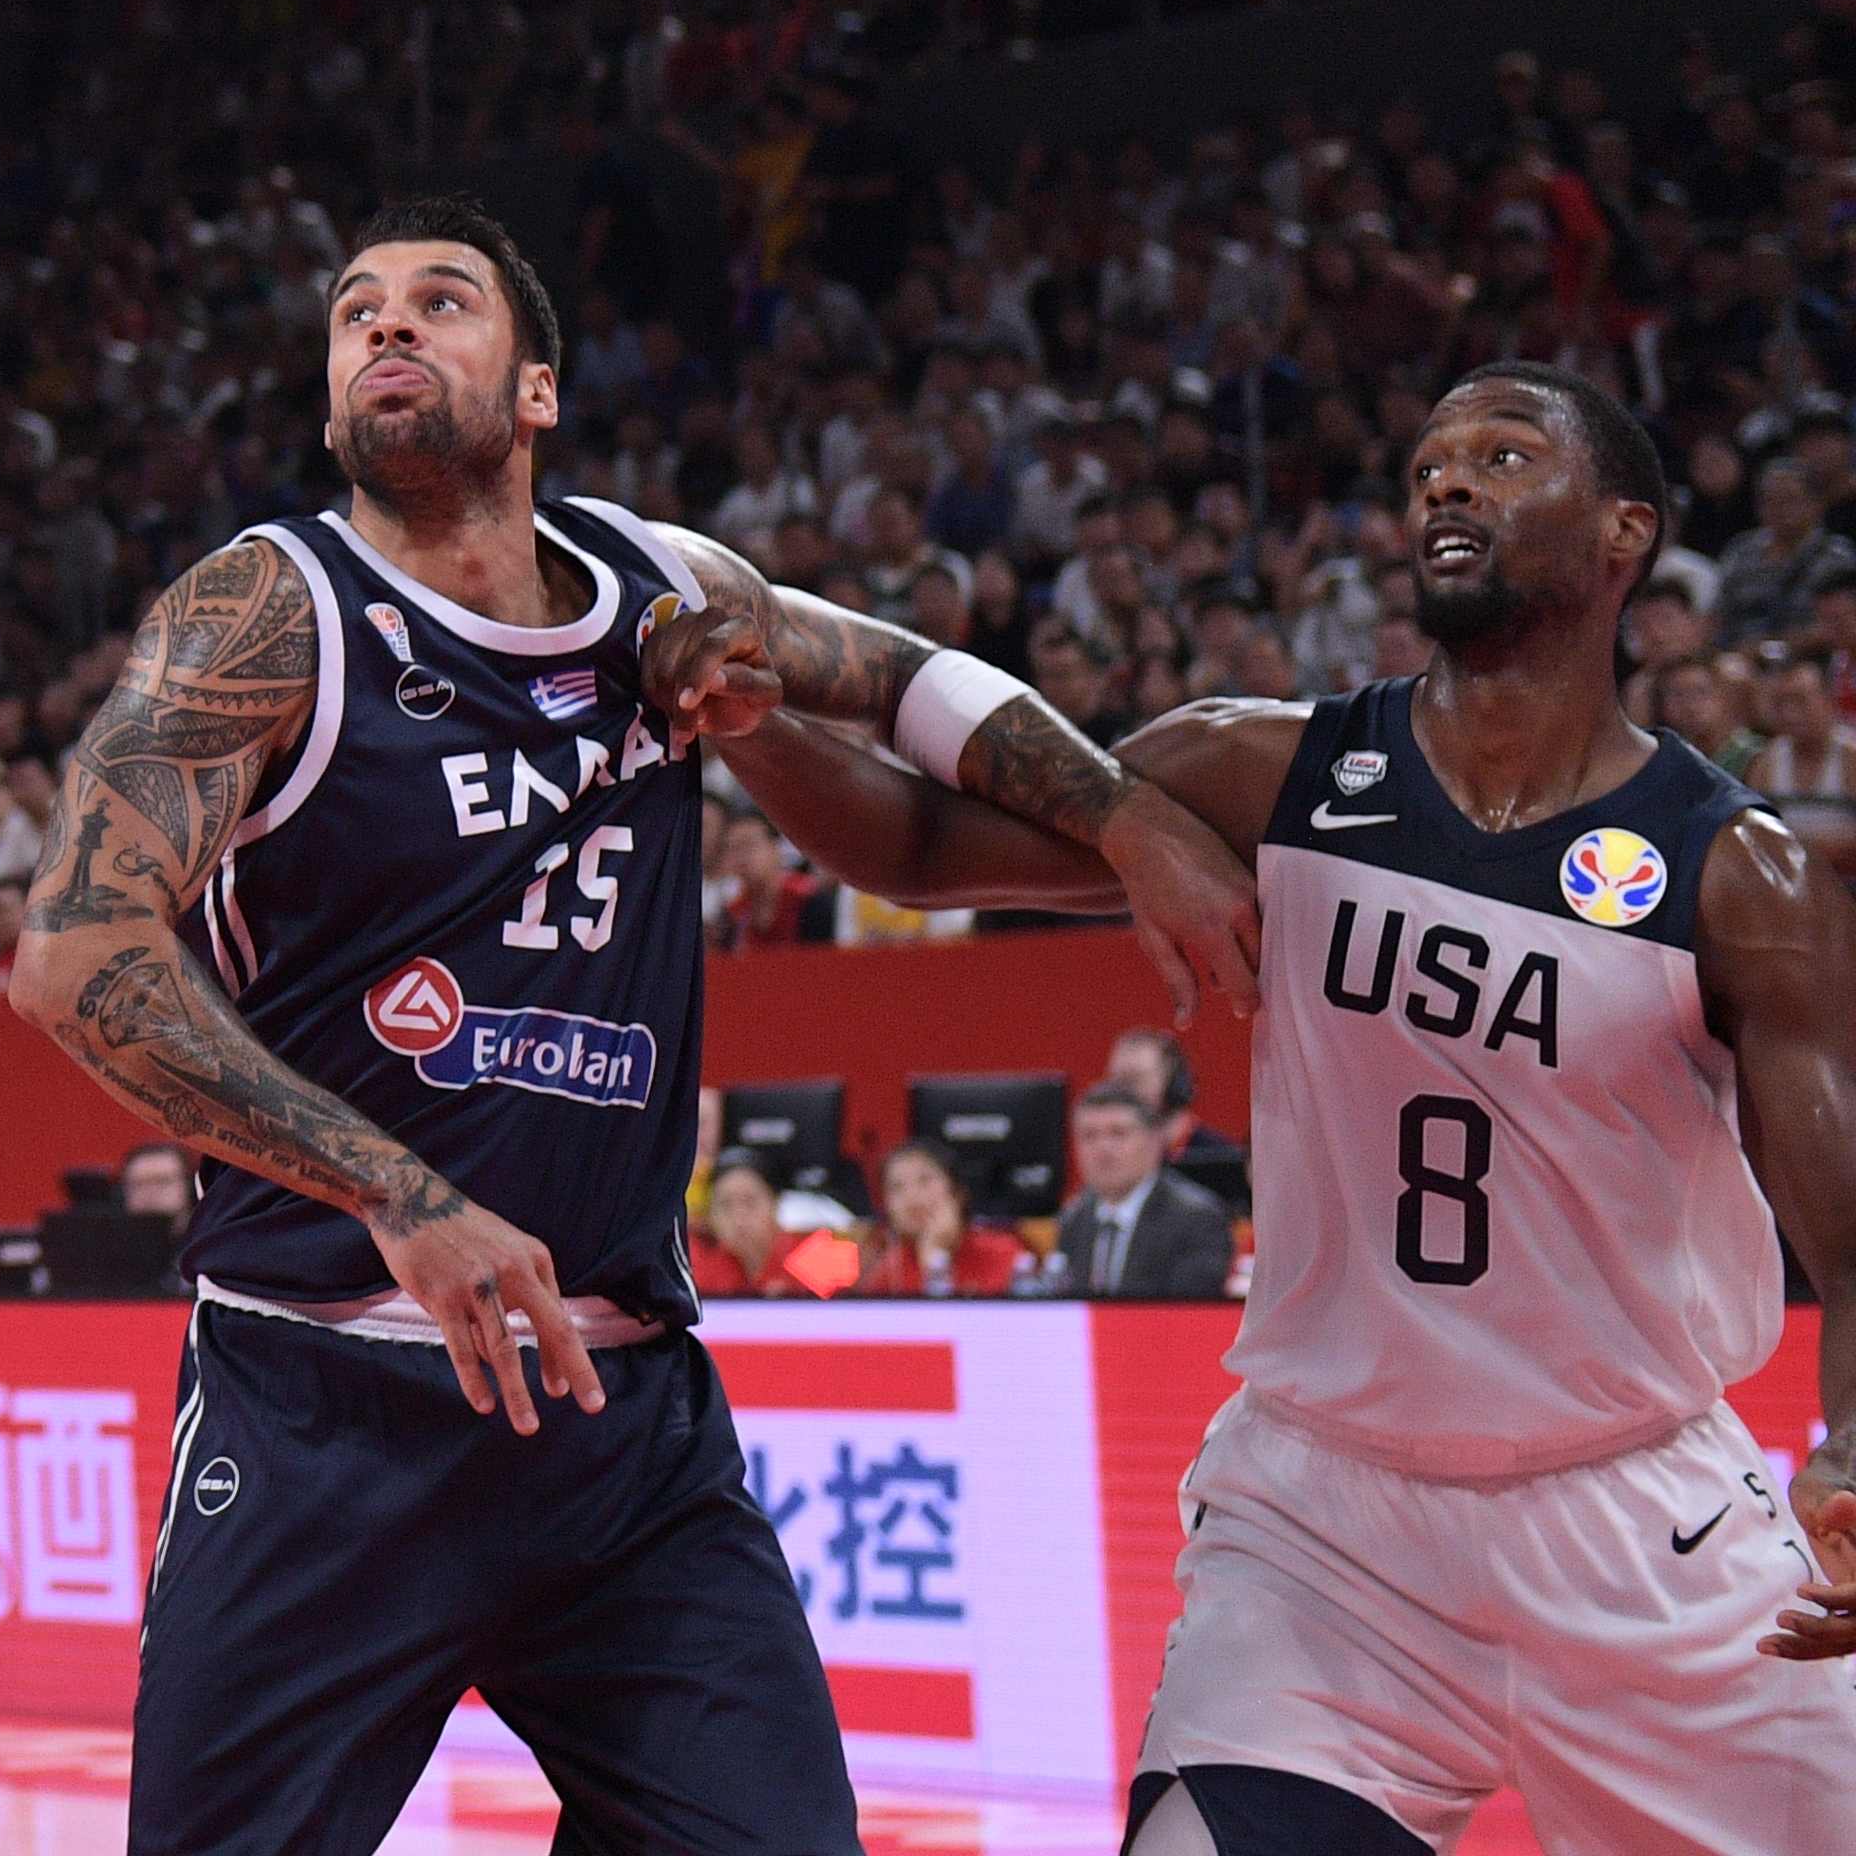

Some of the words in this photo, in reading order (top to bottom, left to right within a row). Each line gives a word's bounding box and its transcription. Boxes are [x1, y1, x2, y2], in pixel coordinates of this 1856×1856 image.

[502, 825, 634, 953] 15
[1323, 899, 1559, 1069] USA
[1396, 1093, 1492, 1287] 8
